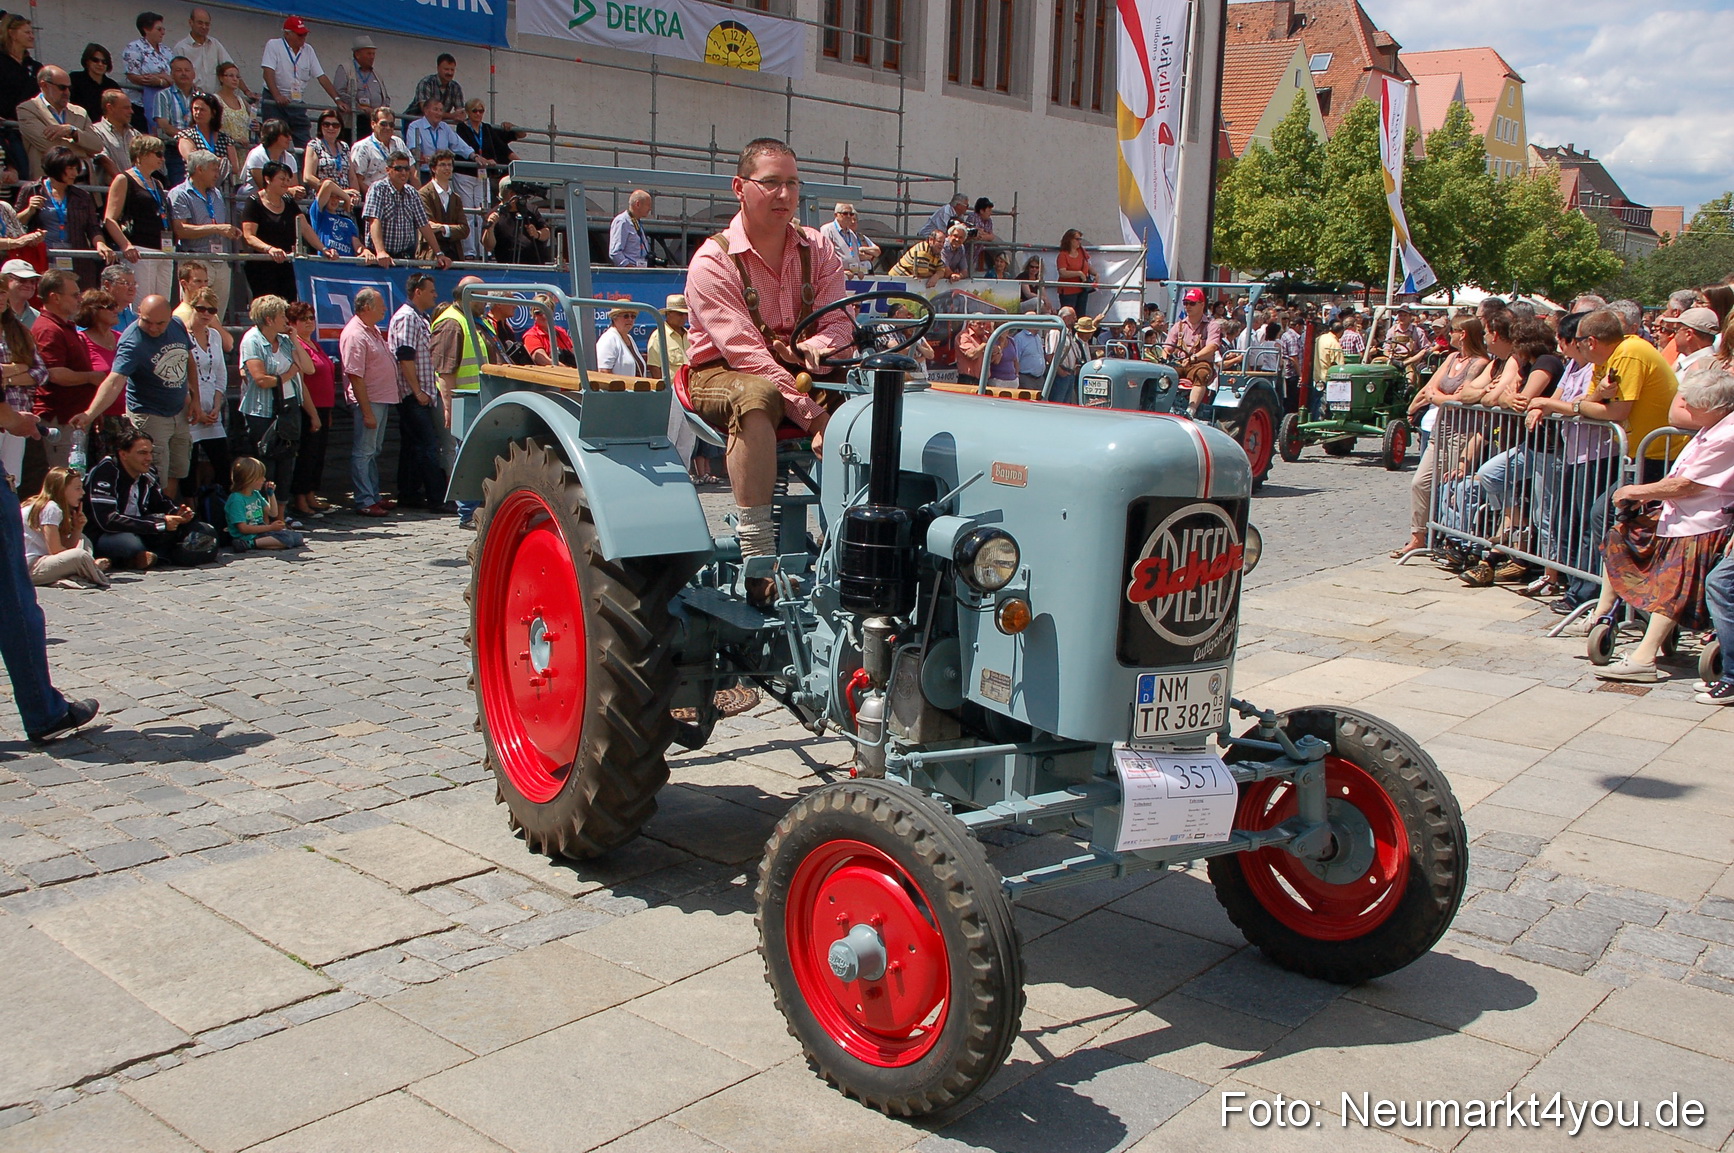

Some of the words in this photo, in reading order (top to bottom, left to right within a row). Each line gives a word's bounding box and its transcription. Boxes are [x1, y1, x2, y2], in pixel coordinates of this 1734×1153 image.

[606, 1, 685, 40] DEKRA
[730, 30, 738, 41] 12
[739, 34, 747, 46] 11
[633, 325, 646, 336] eG
[1126, 543, 1244, 605] Eicher
[1158, 676, 1189, 703] NM
[1143, 693, 1149, 702] D
[1213, 695, 1223, 707] 03
[1140, 706, 1169, 733] TR
[1174, 702, 1211, 730] 382
[1213, 712, 1222, 724] 10
[1173, 764, 1218, 790] 357
